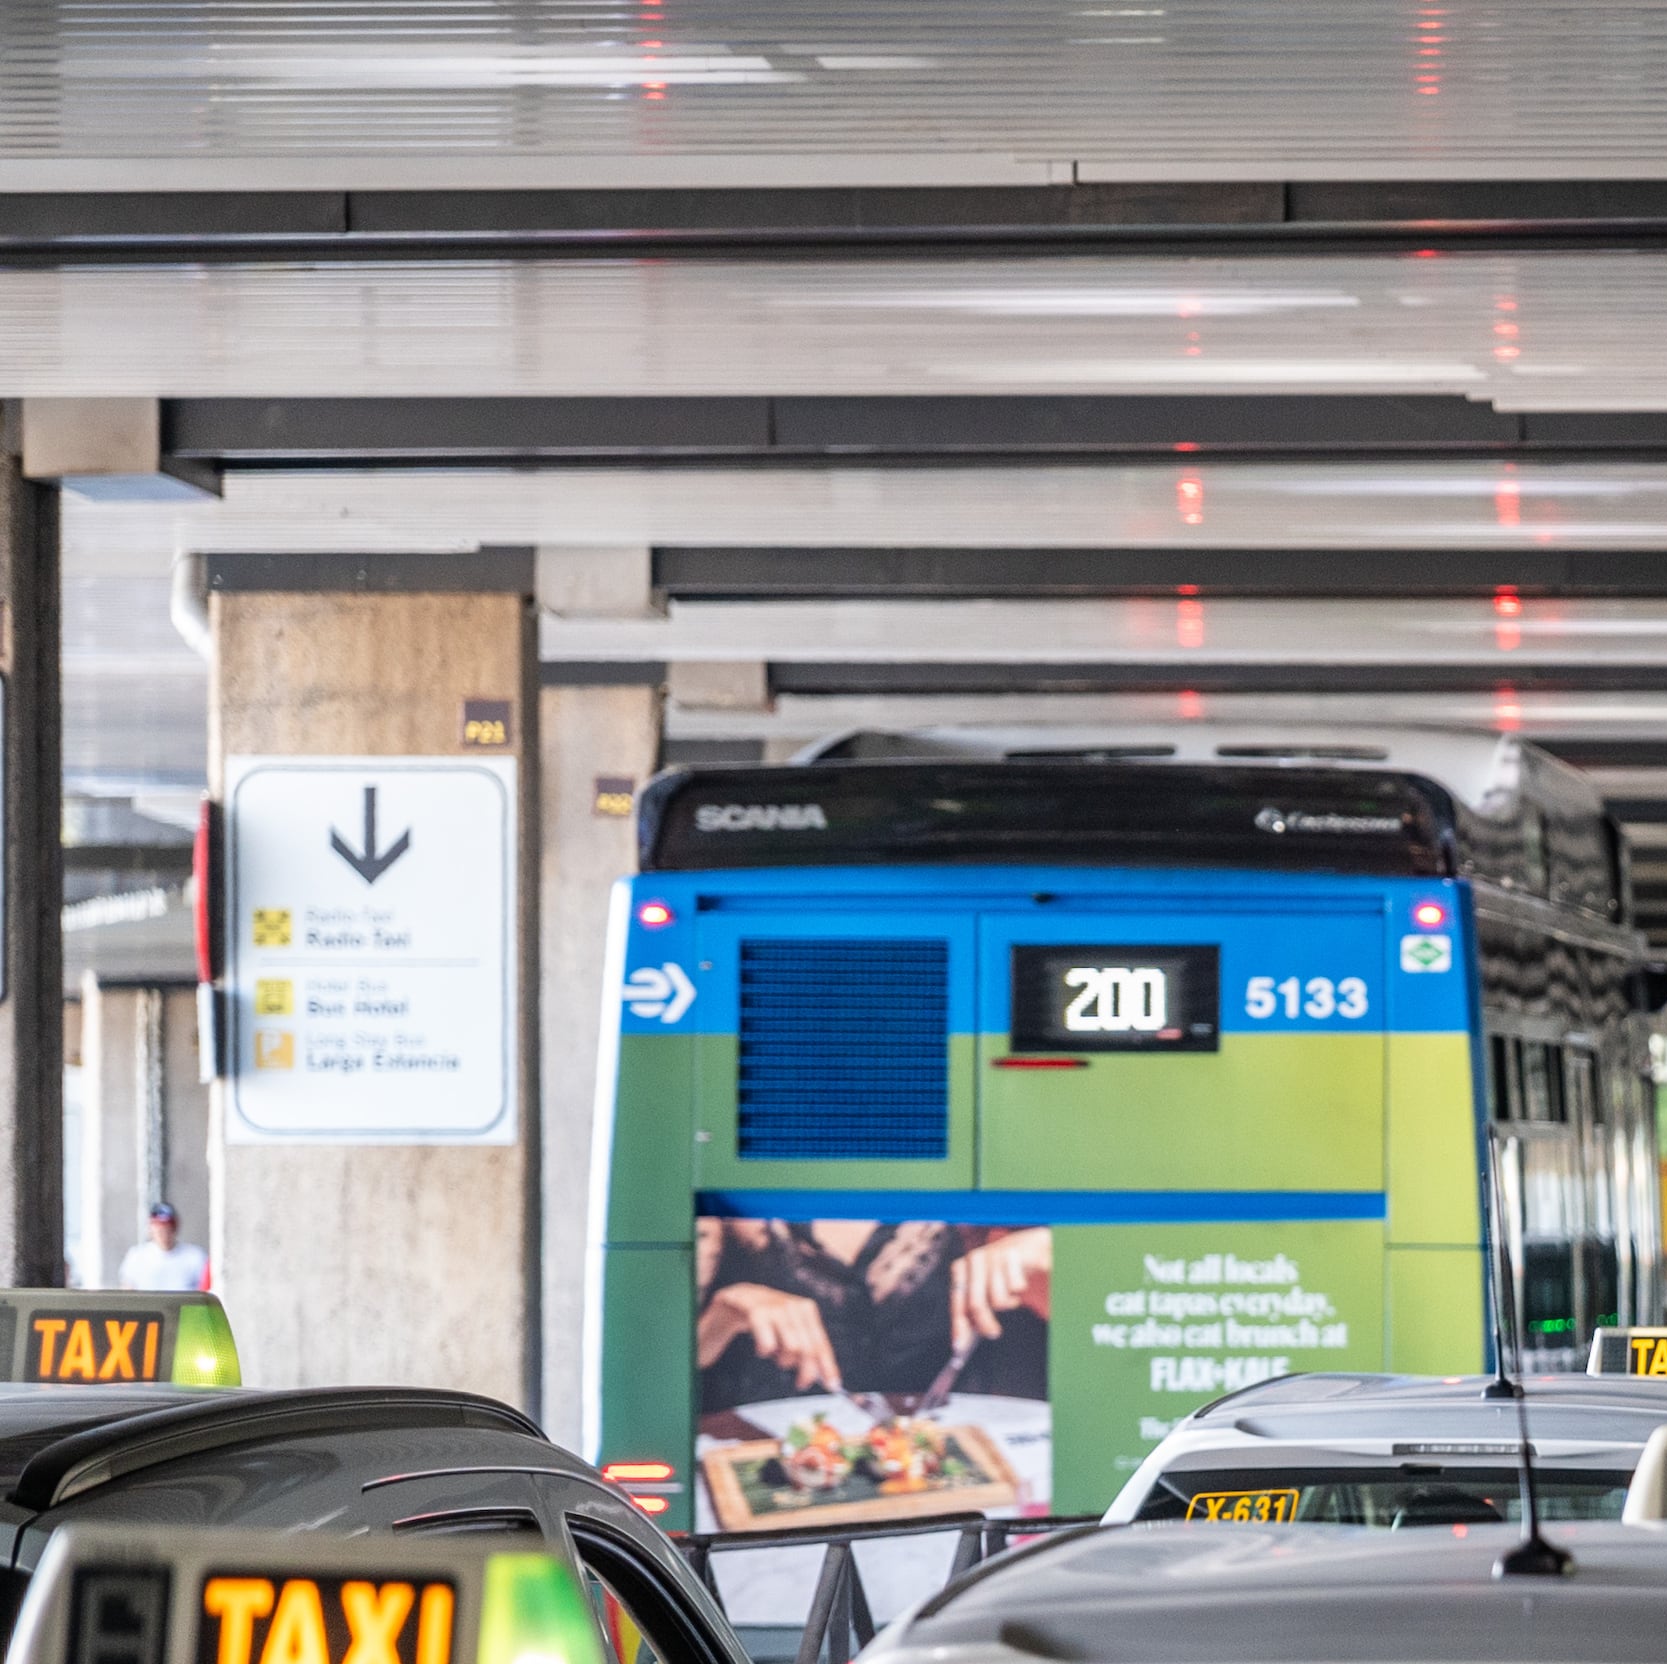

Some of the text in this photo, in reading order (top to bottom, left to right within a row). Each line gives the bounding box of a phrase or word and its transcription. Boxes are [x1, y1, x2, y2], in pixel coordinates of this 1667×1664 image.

[695, 803, 828, 832] SCANIA
[1064, 967, 1164, 1032] 200
[1245, 976, 1368, 1019] 5133
[33, 1319, 159, 1379] TAXI
